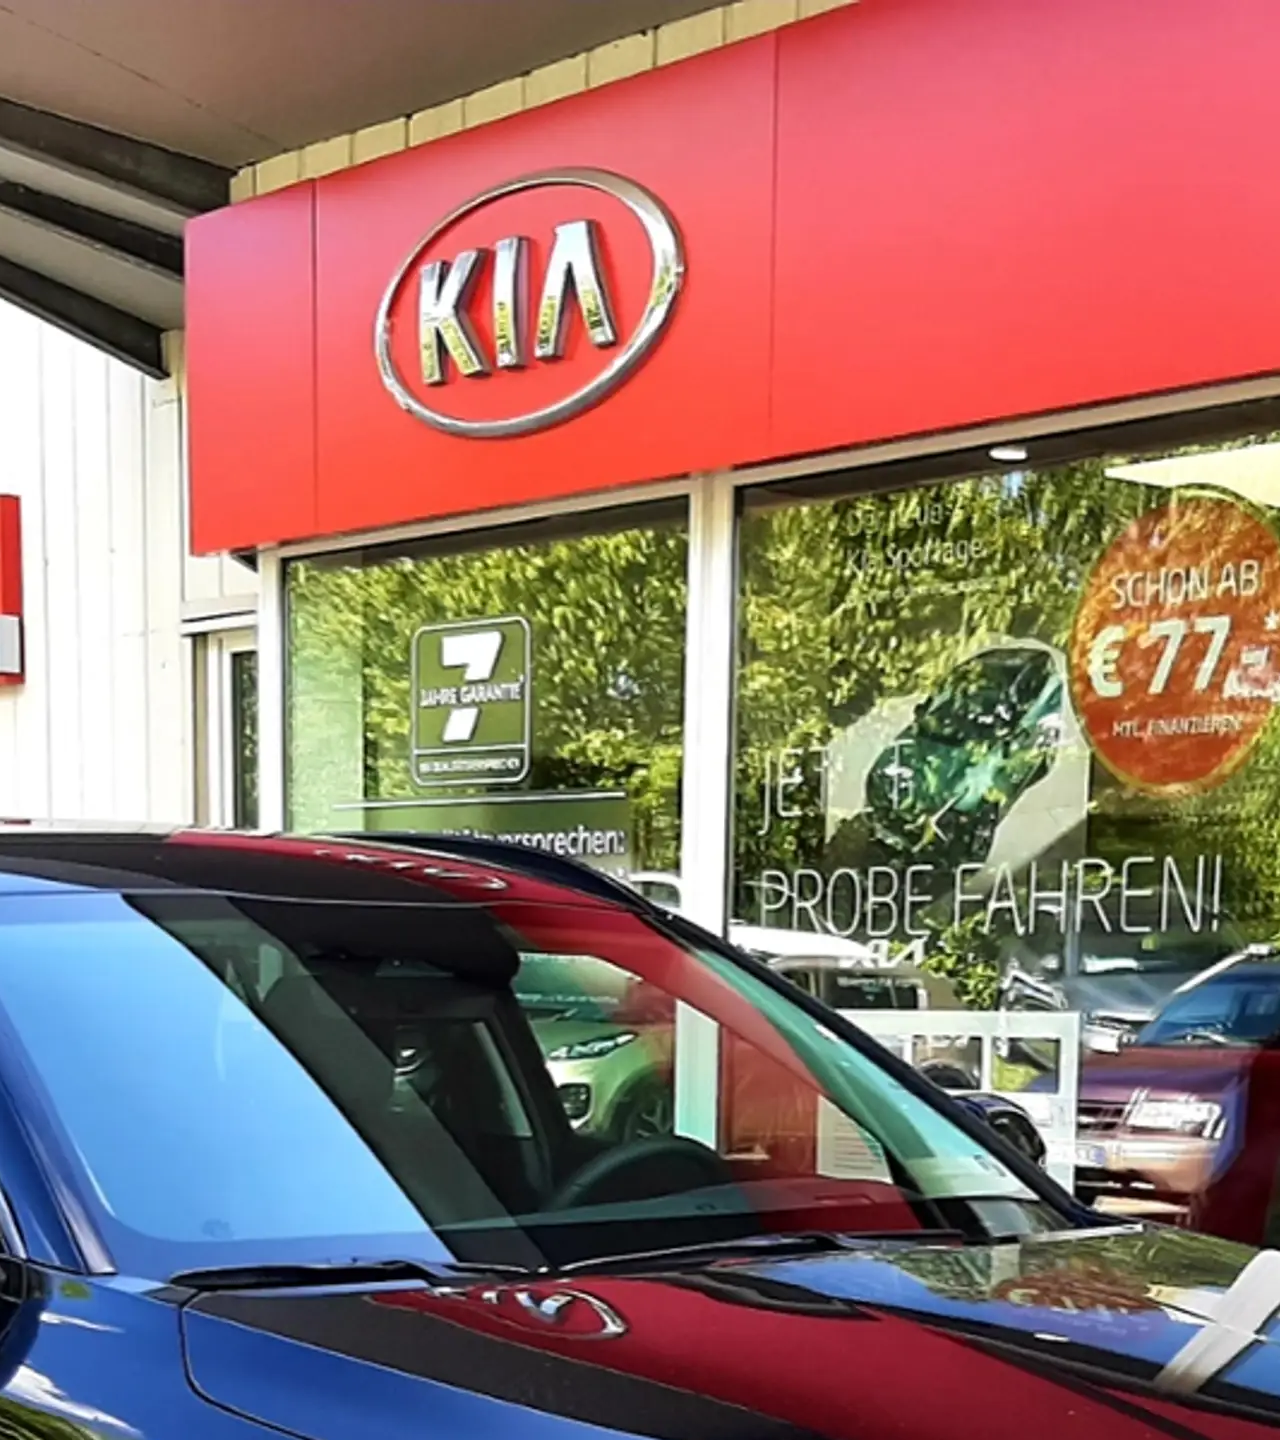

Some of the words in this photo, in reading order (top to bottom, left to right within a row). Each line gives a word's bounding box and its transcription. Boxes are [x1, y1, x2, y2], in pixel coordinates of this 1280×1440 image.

[419, 218, 616, 386] KIA
[1110, 565, 1210, 611] SCHON
[1216, 558, 1260, 597] AB
[441, 630, 502, 743] 7
[760, 864, 934, 937] PROBE
[953, 854, 1223, 937] FAHREN!
